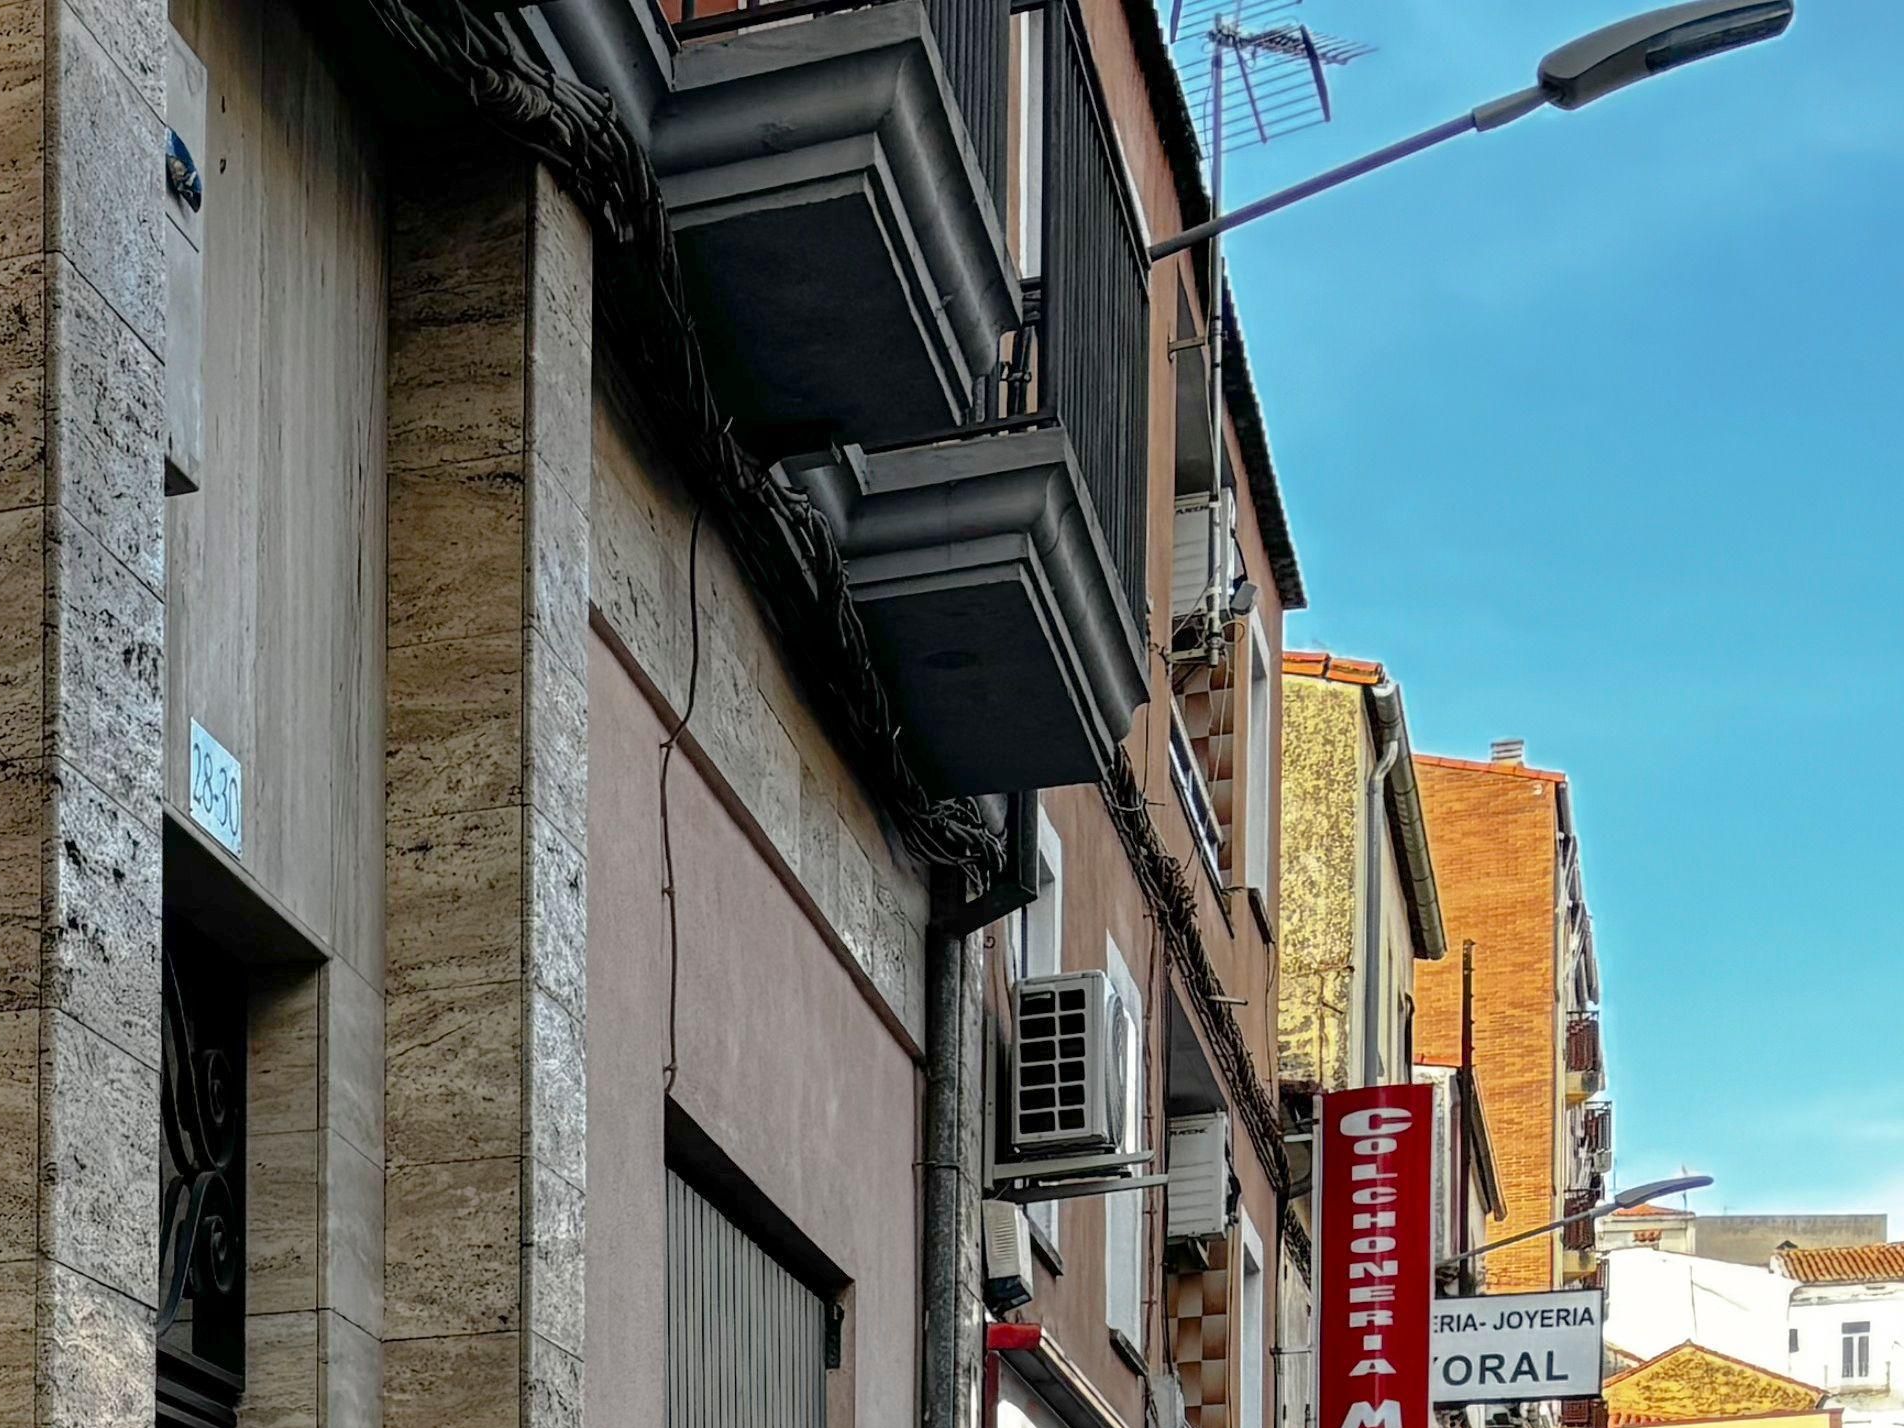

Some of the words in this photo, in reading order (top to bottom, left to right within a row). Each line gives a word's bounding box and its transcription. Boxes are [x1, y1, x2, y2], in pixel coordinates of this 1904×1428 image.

[192, 742, 240, 837] 28-30
[1339, 1107, 1413, 1377] COLCHONERIA
[1493, 1306, 1595, 1332] JOYERIA
[1433, 1350, 1569, 1387] ORAL
